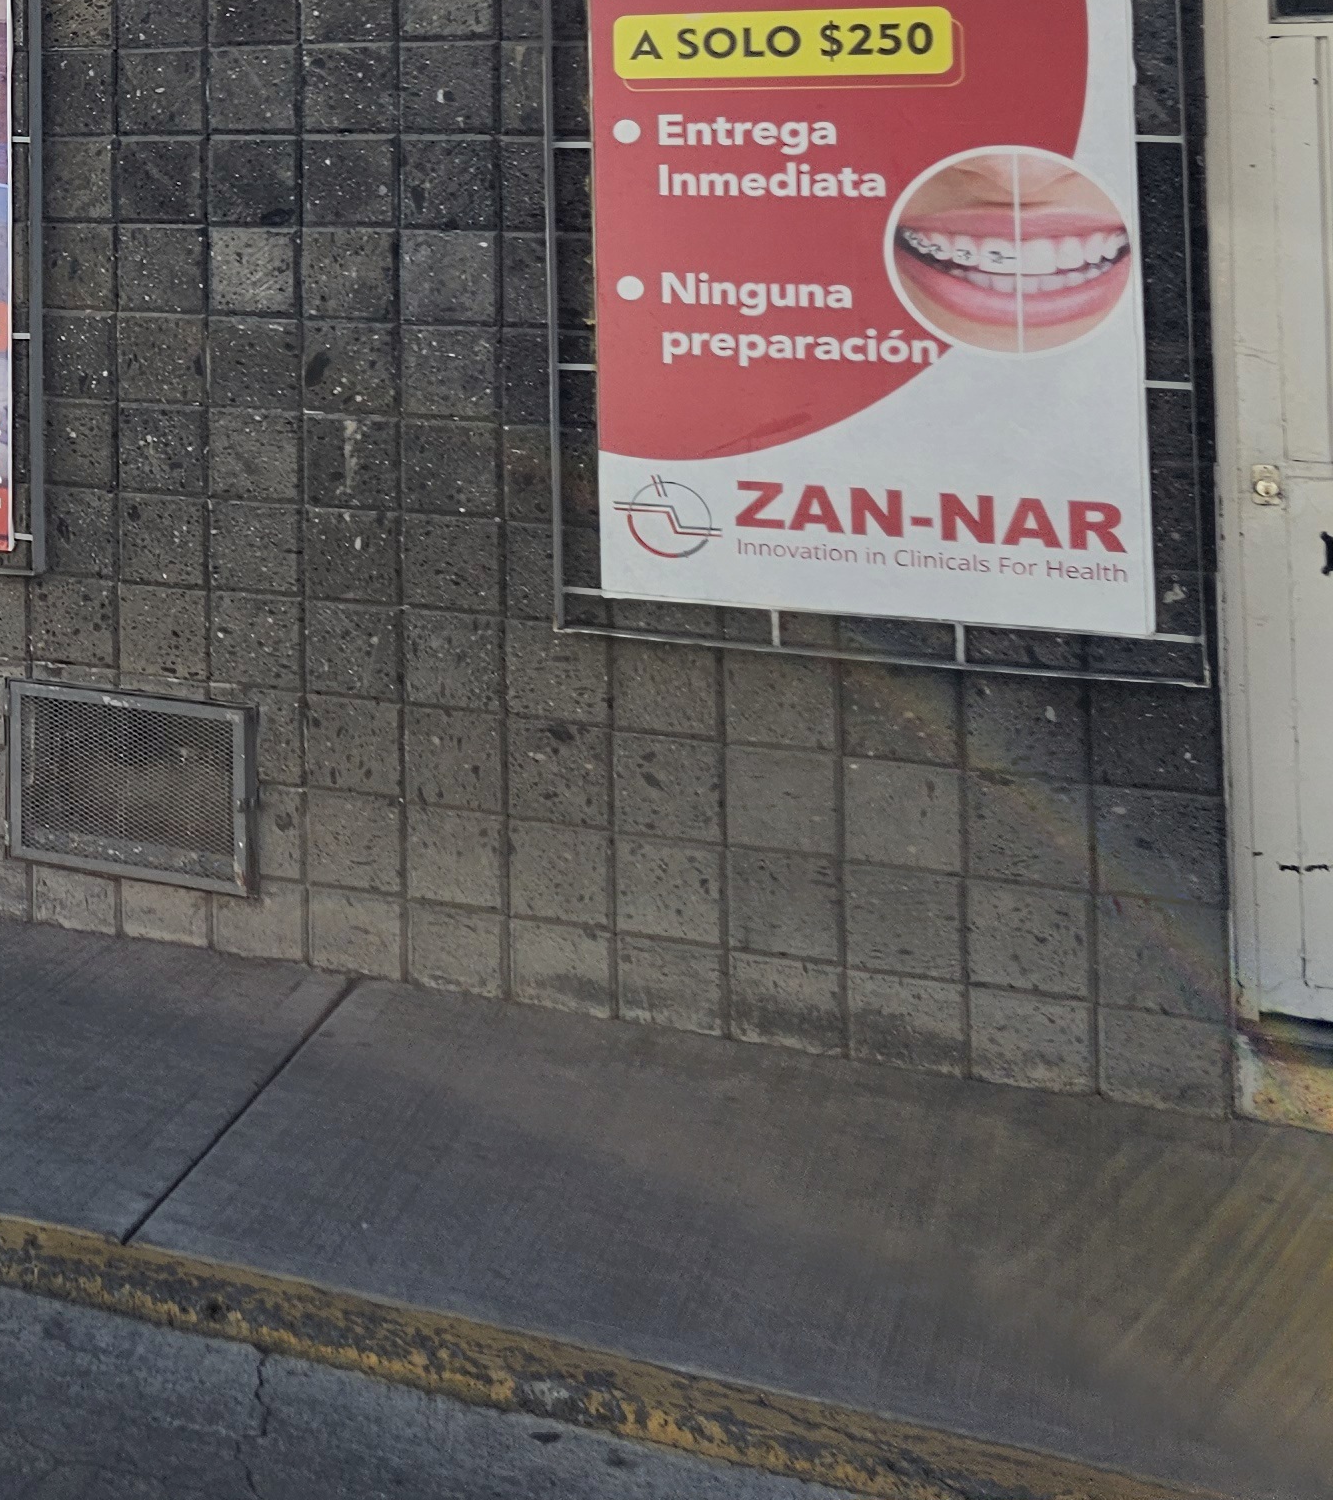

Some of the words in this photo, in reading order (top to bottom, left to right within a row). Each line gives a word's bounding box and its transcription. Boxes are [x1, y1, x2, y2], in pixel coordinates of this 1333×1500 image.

[629, 30, 663, 61] A
[676, 26, 801, 59] SOLO
[819, 20, 933, 62] $250
[657, 113, 837, 155] Entrega
[658, 163, 886, 198] Inmediata
[661, 271, 853, 315] Ninguna
[661, 327, 938, 366] preparación
[734, 479, 1129, 553] ZAN-NAR
[736, 537, 858, 562] Innovation
[866, 545, 887, 566] in
[893, 547, 991, 574] Clinicals
[999, 556, 1038, 578] For
[1046, 558, 1129, 584] Health
